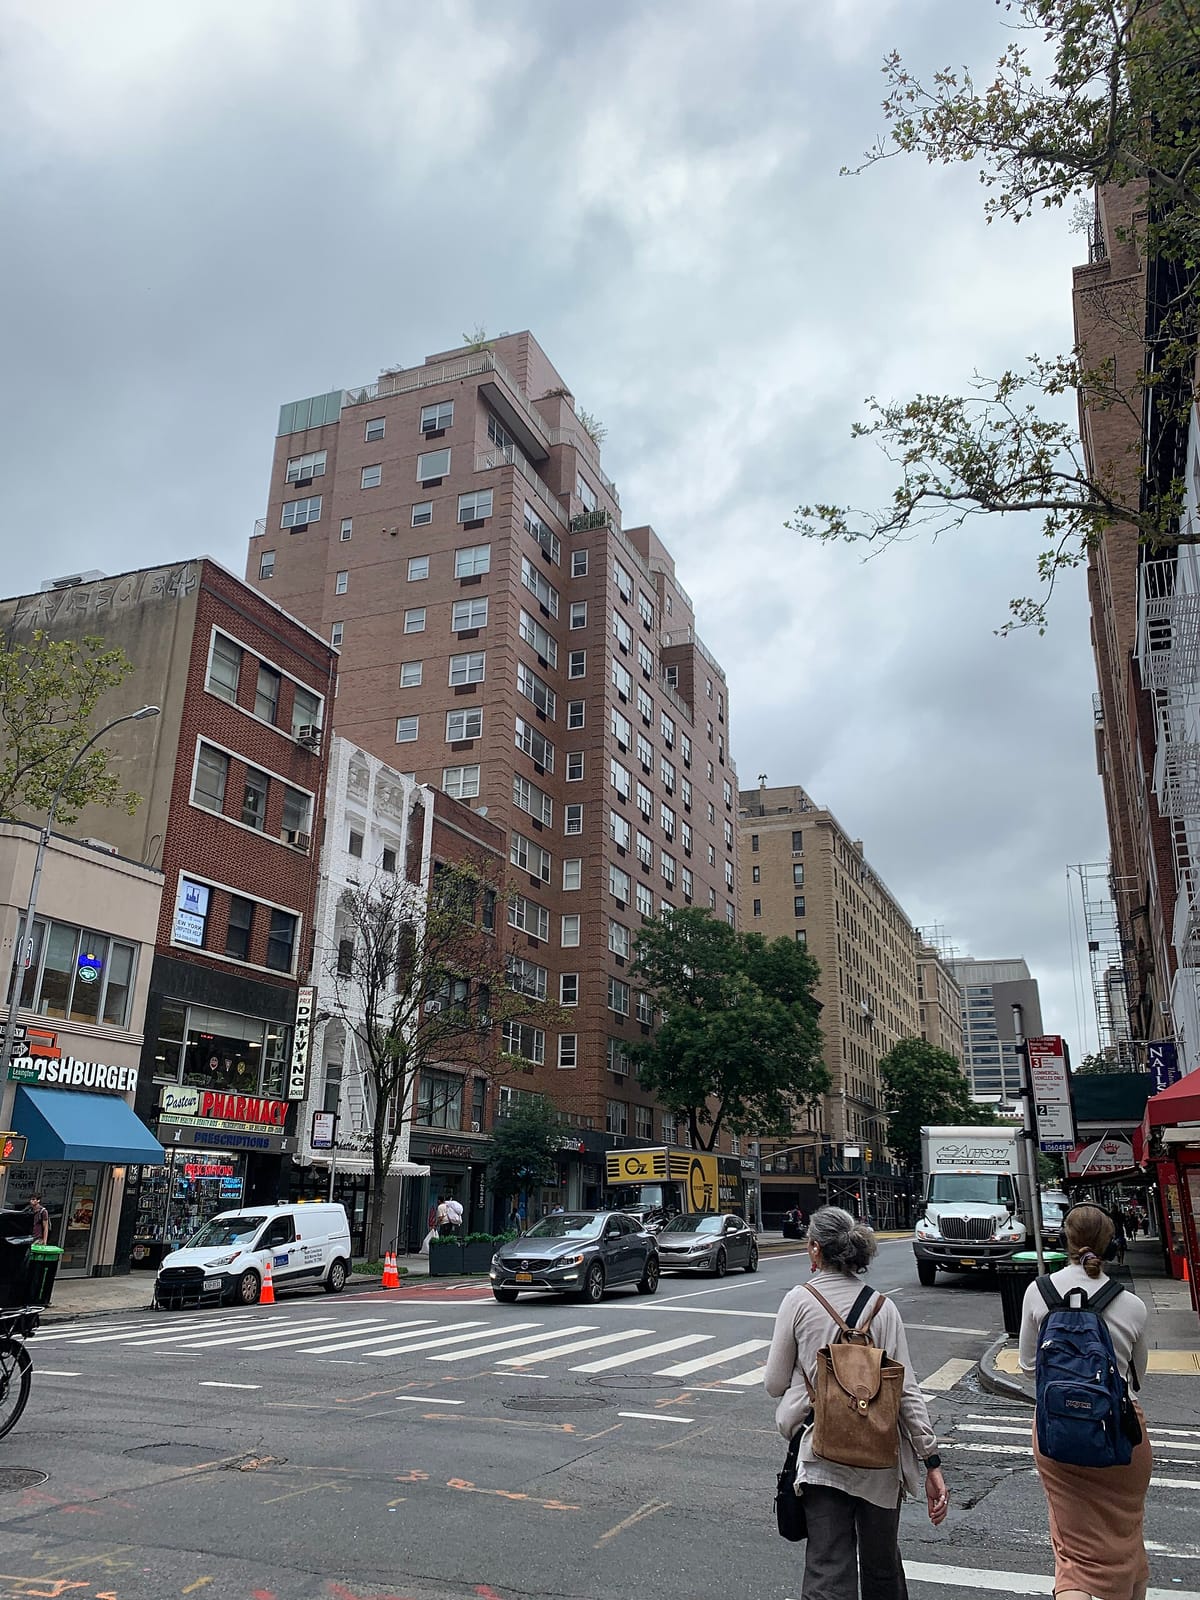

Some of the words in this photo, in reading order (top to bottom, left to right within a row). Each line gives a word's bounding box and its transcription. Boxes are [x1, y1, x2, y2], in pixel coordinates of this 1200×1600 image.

[291, 1006, 310, 1087] DRIVING
[1033, 1058, 1040, 1068] 3
[1150, 1046, 1167, 1091] NAILS
[165, 1094, 196, 1112] Pasteur
[201, 1090, 290, 1126] PHARMACY
[1039, 1106, 1046, 1115] 2
[194, 1131, 270, 1149] PRESCRIPTIONS
